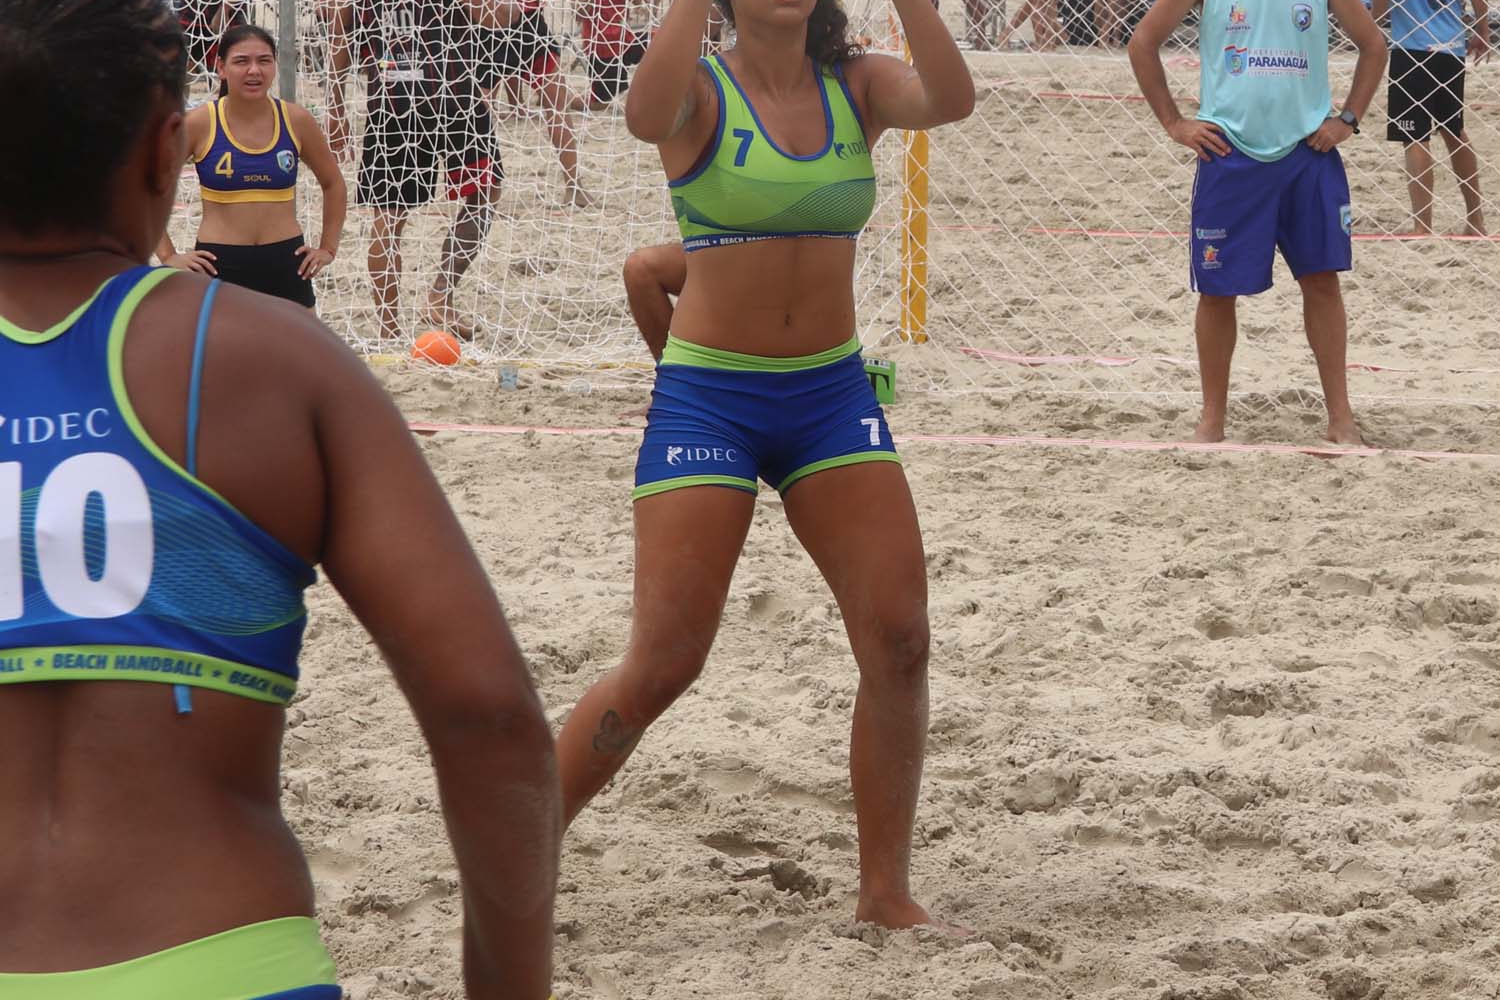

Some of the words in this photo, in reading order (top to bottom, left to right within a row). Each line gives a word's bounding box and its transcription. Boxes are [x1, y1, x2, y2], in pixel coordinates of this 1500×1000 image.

[733, 128, 754, 167] 7
[215, 151, 235, 178] 4
[11, 407, 112, 445] IDEC
[860, 417, 881, 446] 7
[686, 447, 737, 463] IDEC
[52, 653, 107, 669] BEACH
[113, 655, 204, 678] HANDBALL
